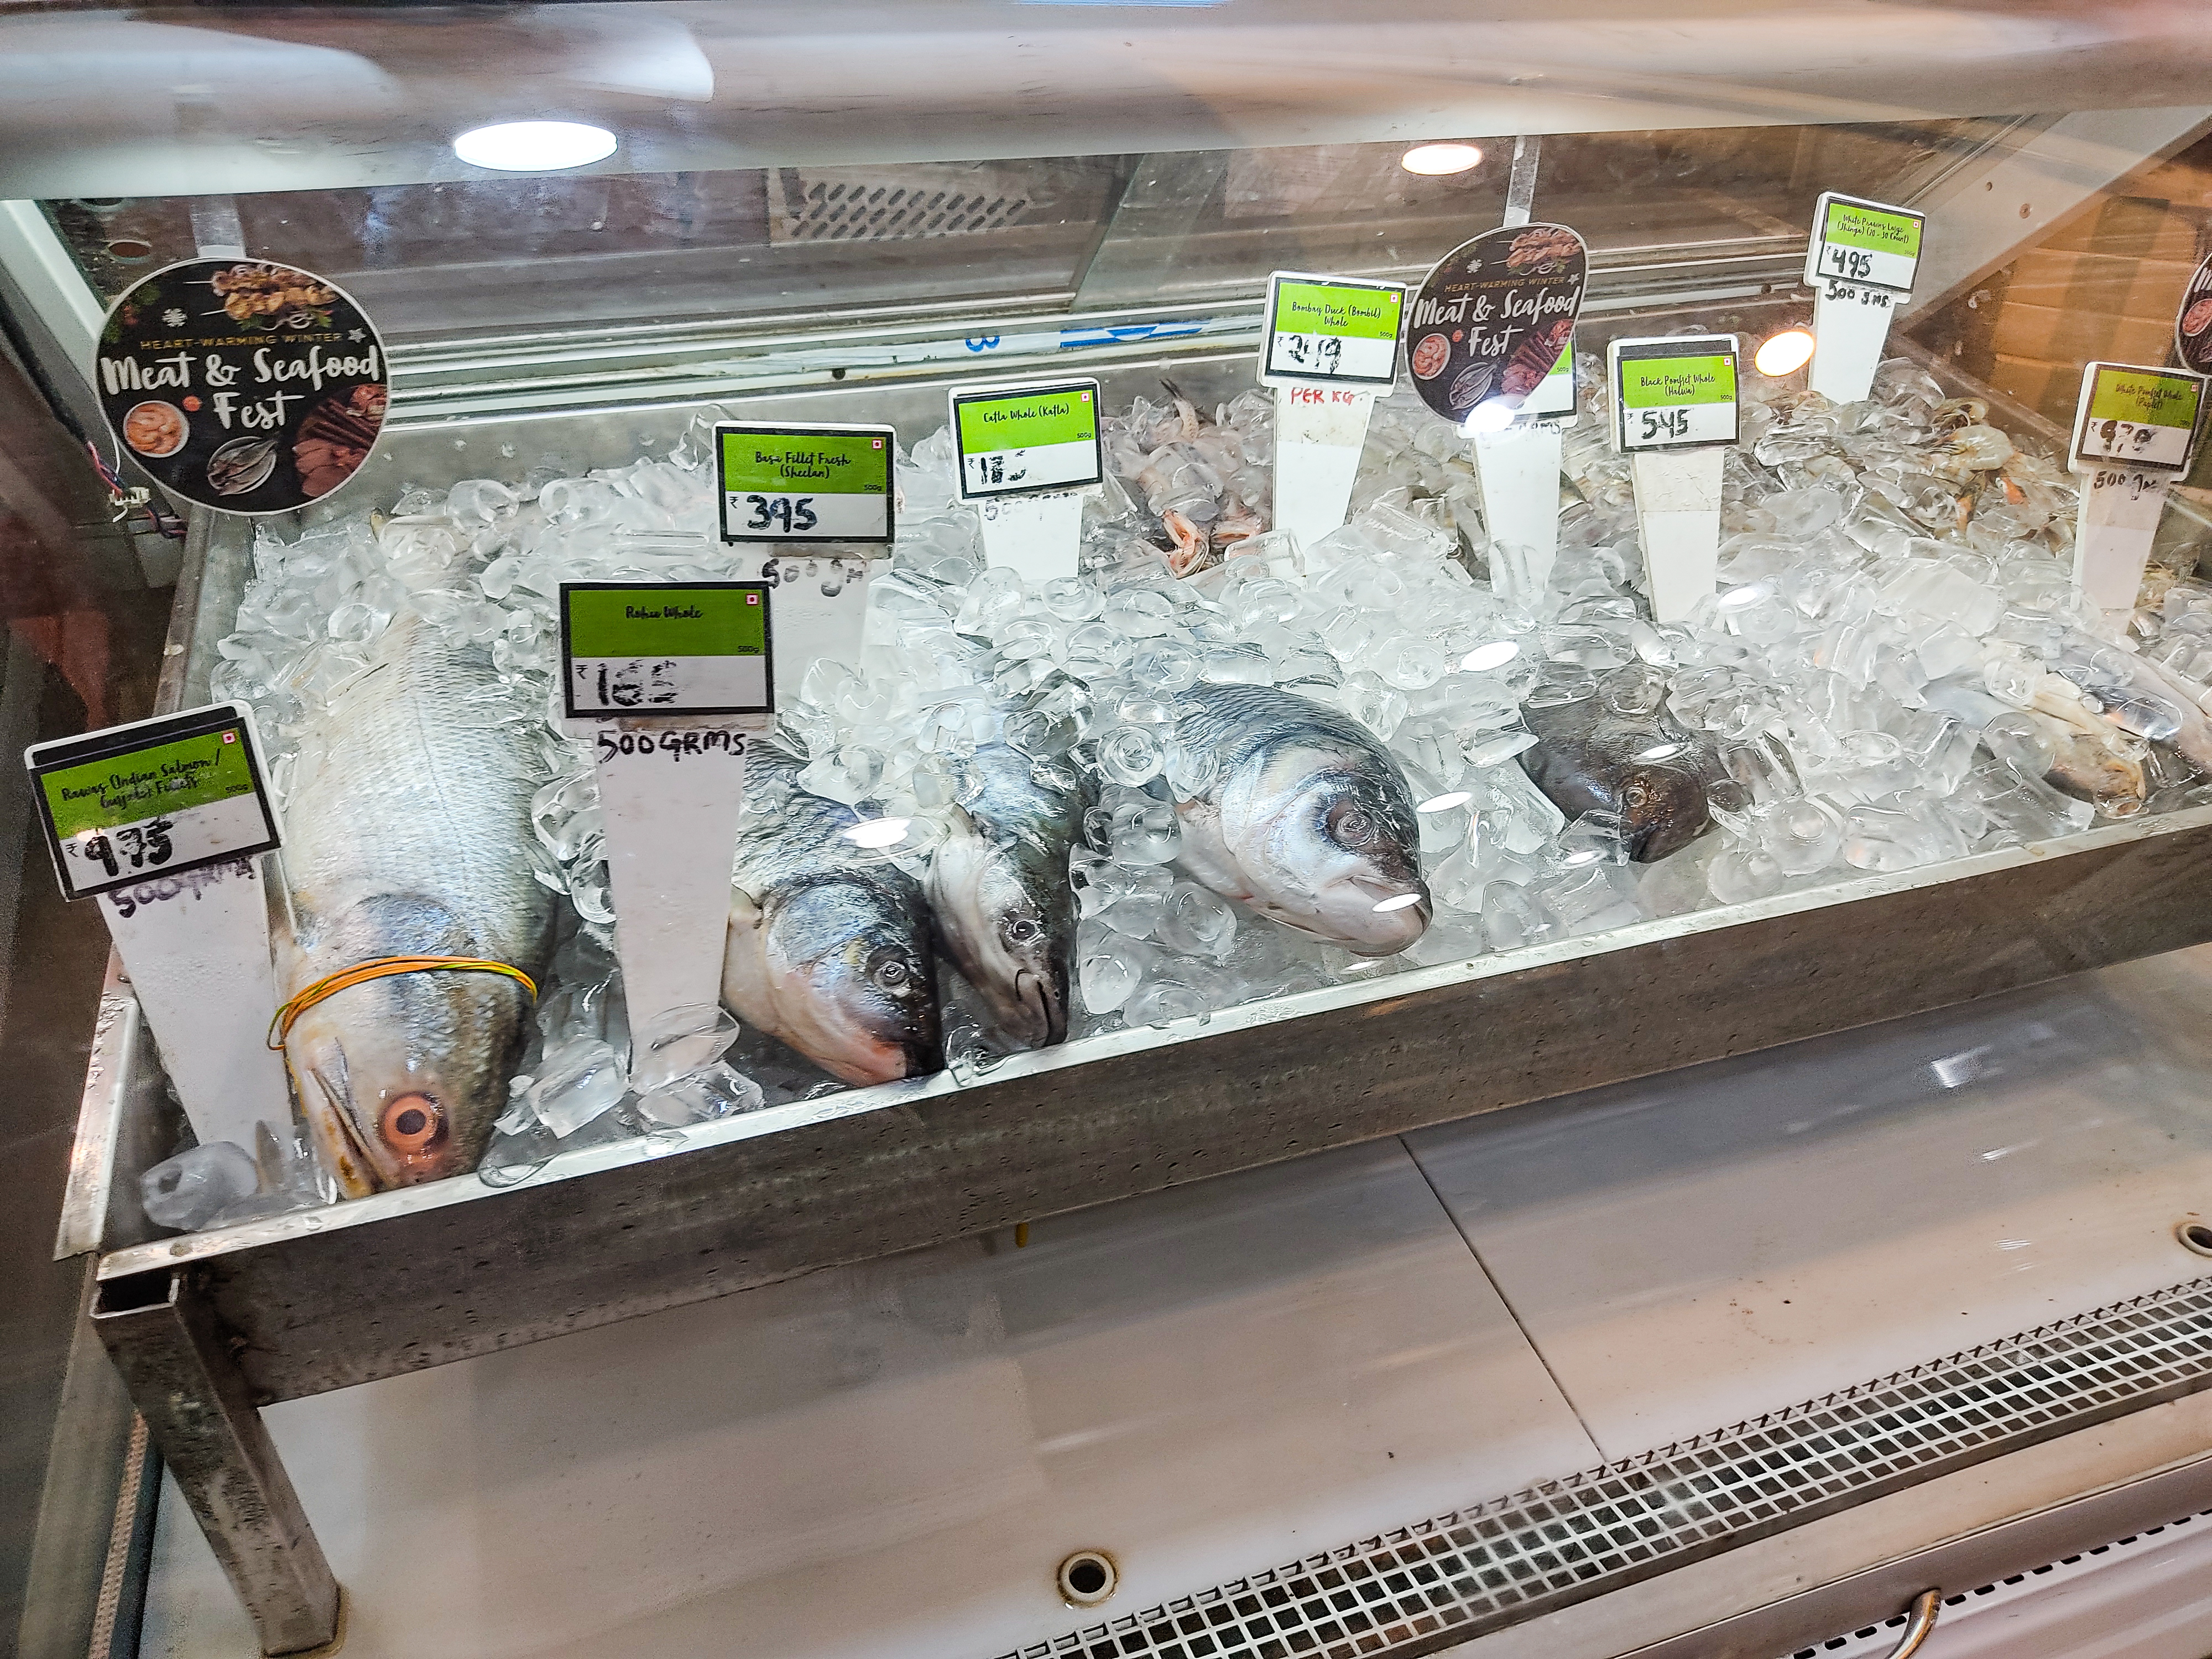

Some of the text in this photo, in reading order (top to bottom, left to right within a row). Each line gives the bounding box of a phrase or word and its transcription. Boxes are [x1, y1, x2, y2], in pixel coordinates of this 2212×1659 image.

[1843, 213, 1904, 236] White Prawns Large
[1890, 232, 1909, 243] Count)
[1832, 248, 1873, 279] 495
[1444, 276, 1566, 293] HEART-WARMING WINTER
[1824, 279, 1855, 301] 500
[1292, 301, 1381, 319] Bombay Duck (Bombil)
[1413, 285, 1582, 329] Meat & Seafood
[1324, 316, 1349, 327] Whole
[140, 332, 342, 349] HEART-WARMING WINTER
[1468, 324, 1525, 358] Fest
[100, 345, 381, 395] Meat & Seafood
[1641, 372, 1715, 387] Black Pomfret Whole
[1291, 387, 1355, 406] PER KG
[1665, 384, 1695, 397] (Halwa)
[212, 389, 306, 429] Fest
[983, 403, 1070, 424] Catla Whole (Katla)
[1641, 408, 1691, 440] 545
[755, 451, 852, 467] Basa Fillet Fresh
[780, 463, 830, 479] (Sheelan)
[745, 494, 818, 533] 395
[737, 645, 759, 654] 500g
